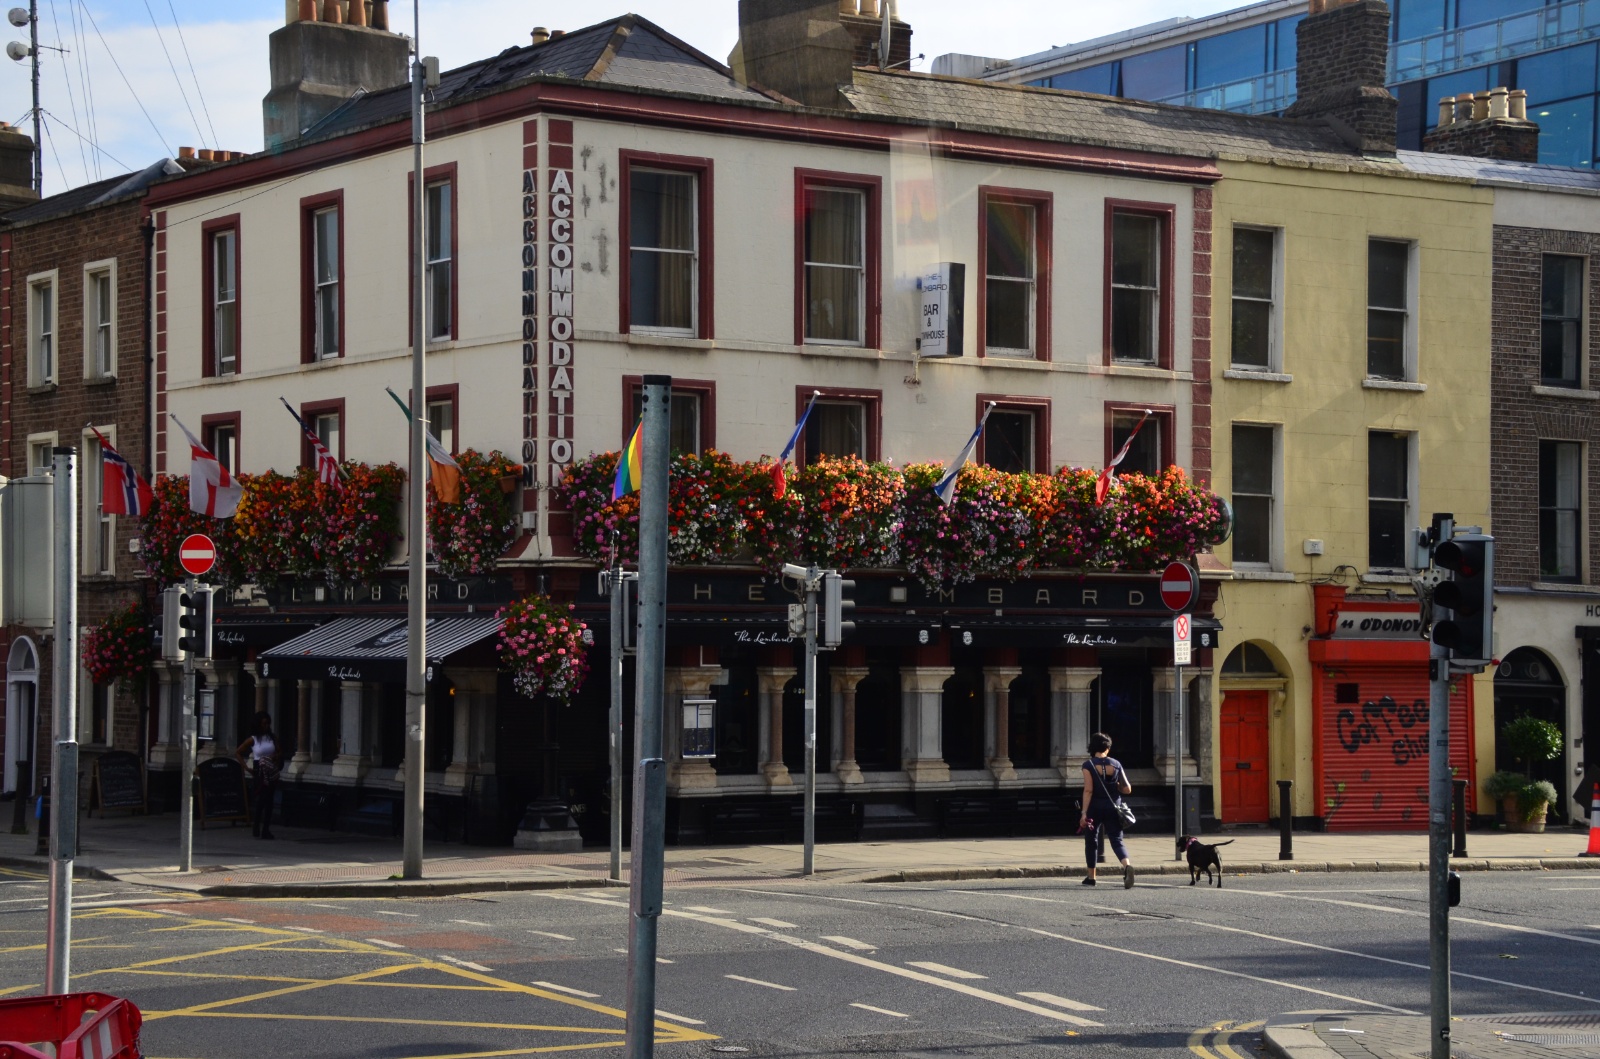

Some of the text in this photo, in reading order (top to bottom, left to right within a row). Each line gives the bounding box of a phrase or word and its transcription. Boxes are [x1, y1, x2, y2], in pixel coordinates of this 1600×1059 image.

[923, 303, 939, 316] BAR
[694, 584, 765, 601] HE
[1360, 618, 1424, 632] O'DONOV
[735, 630, 752, 643] The
[1063, 633, 1117, 645] The Lombard
[1391, 731, 1430, 765] Sho
